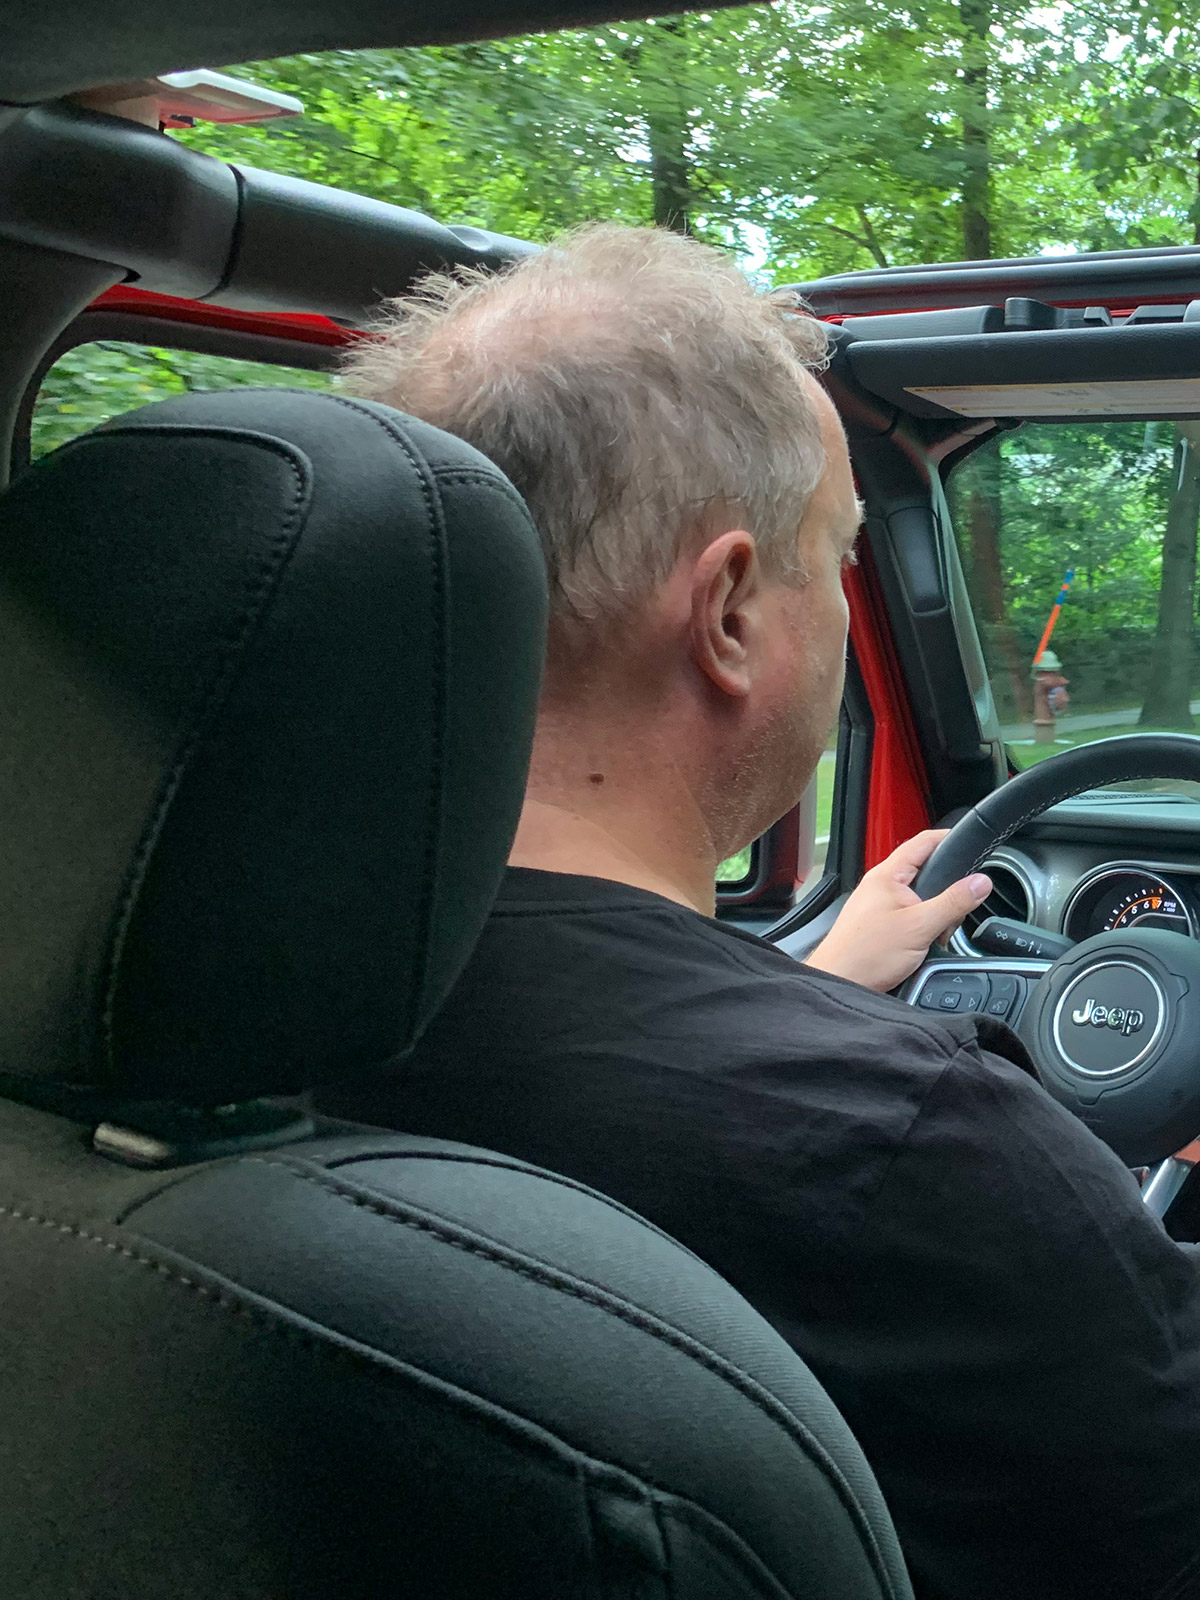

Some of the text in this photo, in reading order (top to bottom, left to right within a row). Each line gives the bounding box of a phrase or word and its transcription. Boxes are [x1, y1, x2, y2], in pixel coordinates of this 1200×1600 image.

[1131, 905, 1138, 914] 5
[1143, 901, 1150, 909] 6
[1072, 998, 1144, 1037] Jeep
